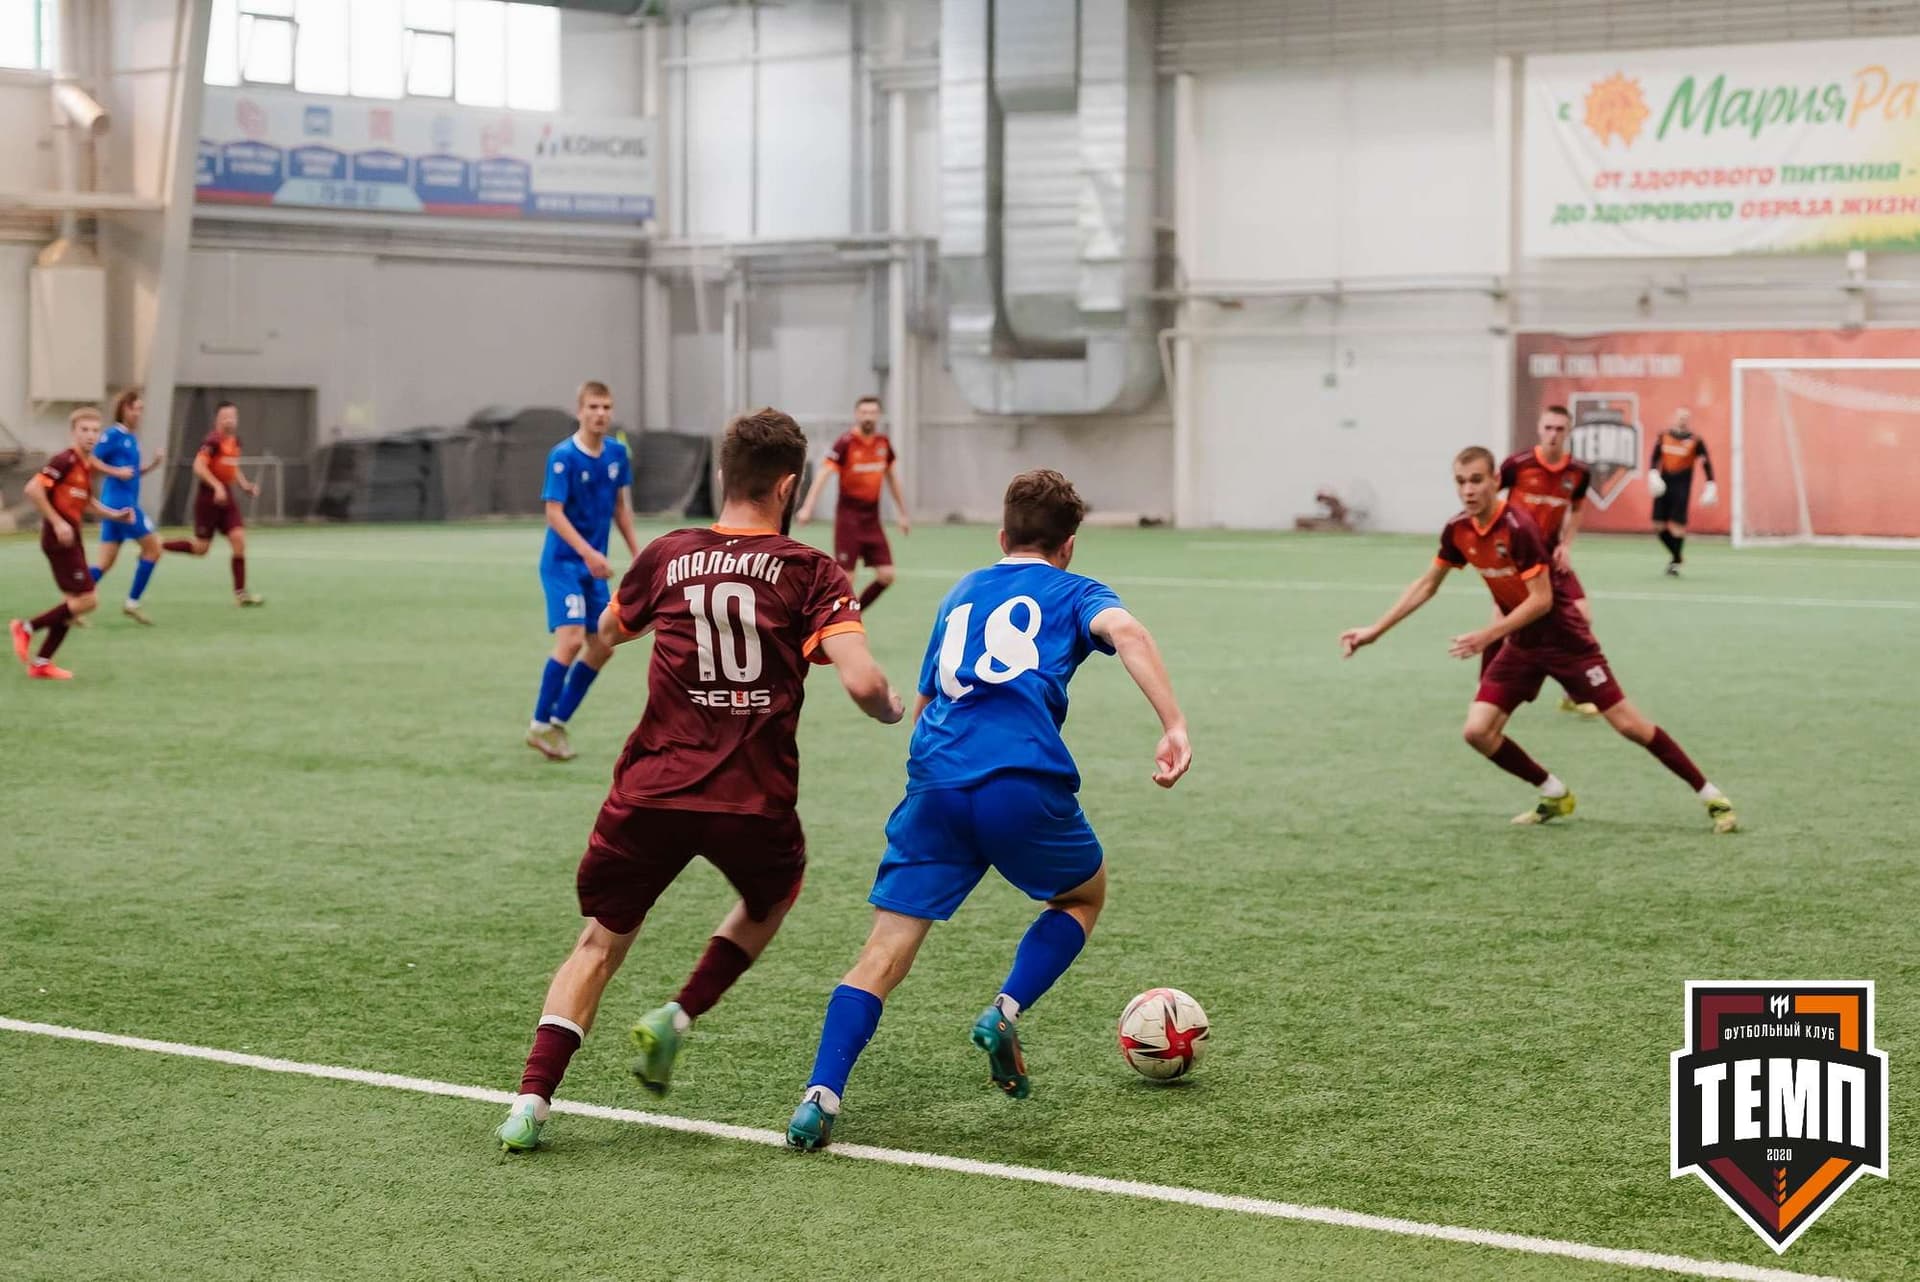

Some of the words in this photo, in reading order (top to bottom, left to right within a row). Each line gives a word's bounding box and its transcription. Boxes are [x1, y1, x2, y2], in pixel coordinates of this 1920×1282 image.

[1594, 170, 1624, 190] ОТ
[1629, 166, 1777, 192] ЗДОРОВОГО
[1780, 162, 1902, 185] ПИТАНИЯ
[1551, 202, 1587, 226] ДО
[1590, 200, 1735, 225] ЗДОРОВОГО
[1738, 198, 1833, 220] ОБРАЗА
[1839, 195, 1920, 217] ЖИЗН
[1571, 423, 1636, 466] ТЕМП
[666, 551, 785, 587] АПАЛЬКИН
[683, 581, 763, 683] 10
[938, 595, 1042, 703] 18
[687, 689, 771, 708] SEUS
